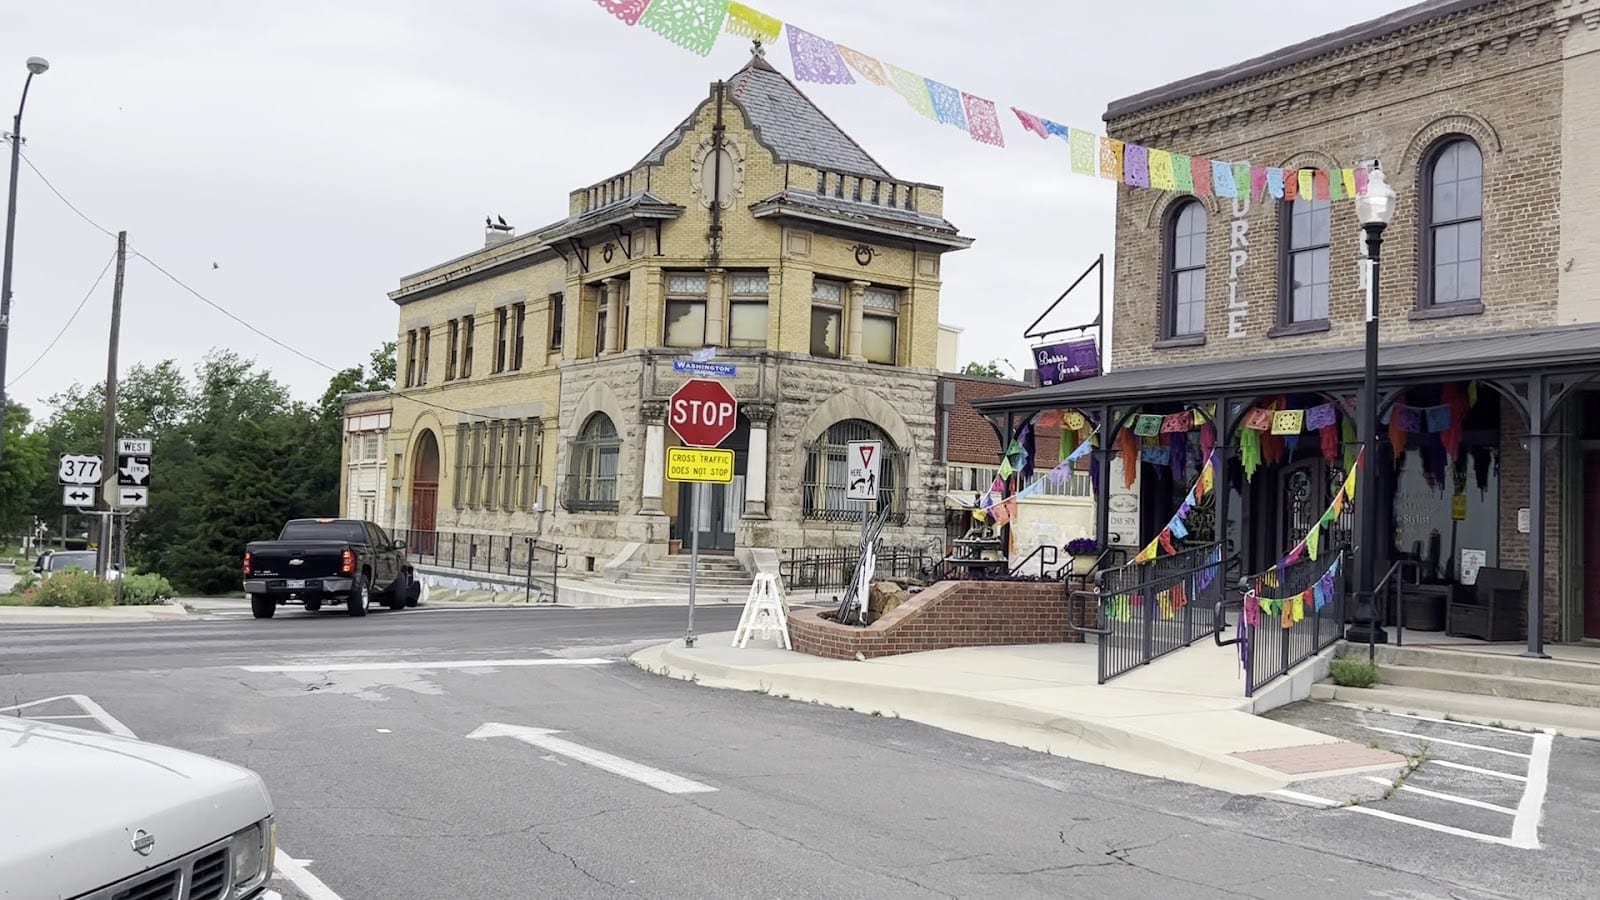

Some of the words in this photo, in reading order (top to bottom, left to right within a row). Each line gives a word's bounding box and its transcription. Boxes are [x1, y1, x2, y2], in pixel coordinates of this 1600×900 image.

[1227, 185, 1250, 338] URPLE
[1039, 351, 1068, 365] Bobbie
[673, 399, 733, 426] STOP
[124, 442, 147, 452] WEST
[672, 454, 696, 463] CROSS
[700, 455, 729, 464] TRAFFIC
[64, 460, 98, 478] 377
[671, 466, 690, 475] DOES
[693, 467, 707, 475] NOT
[710, 468, 729, 477] STOP
[851, 468, 862, 477] HERE
[1403, 514, 1430, 525] Stylist
